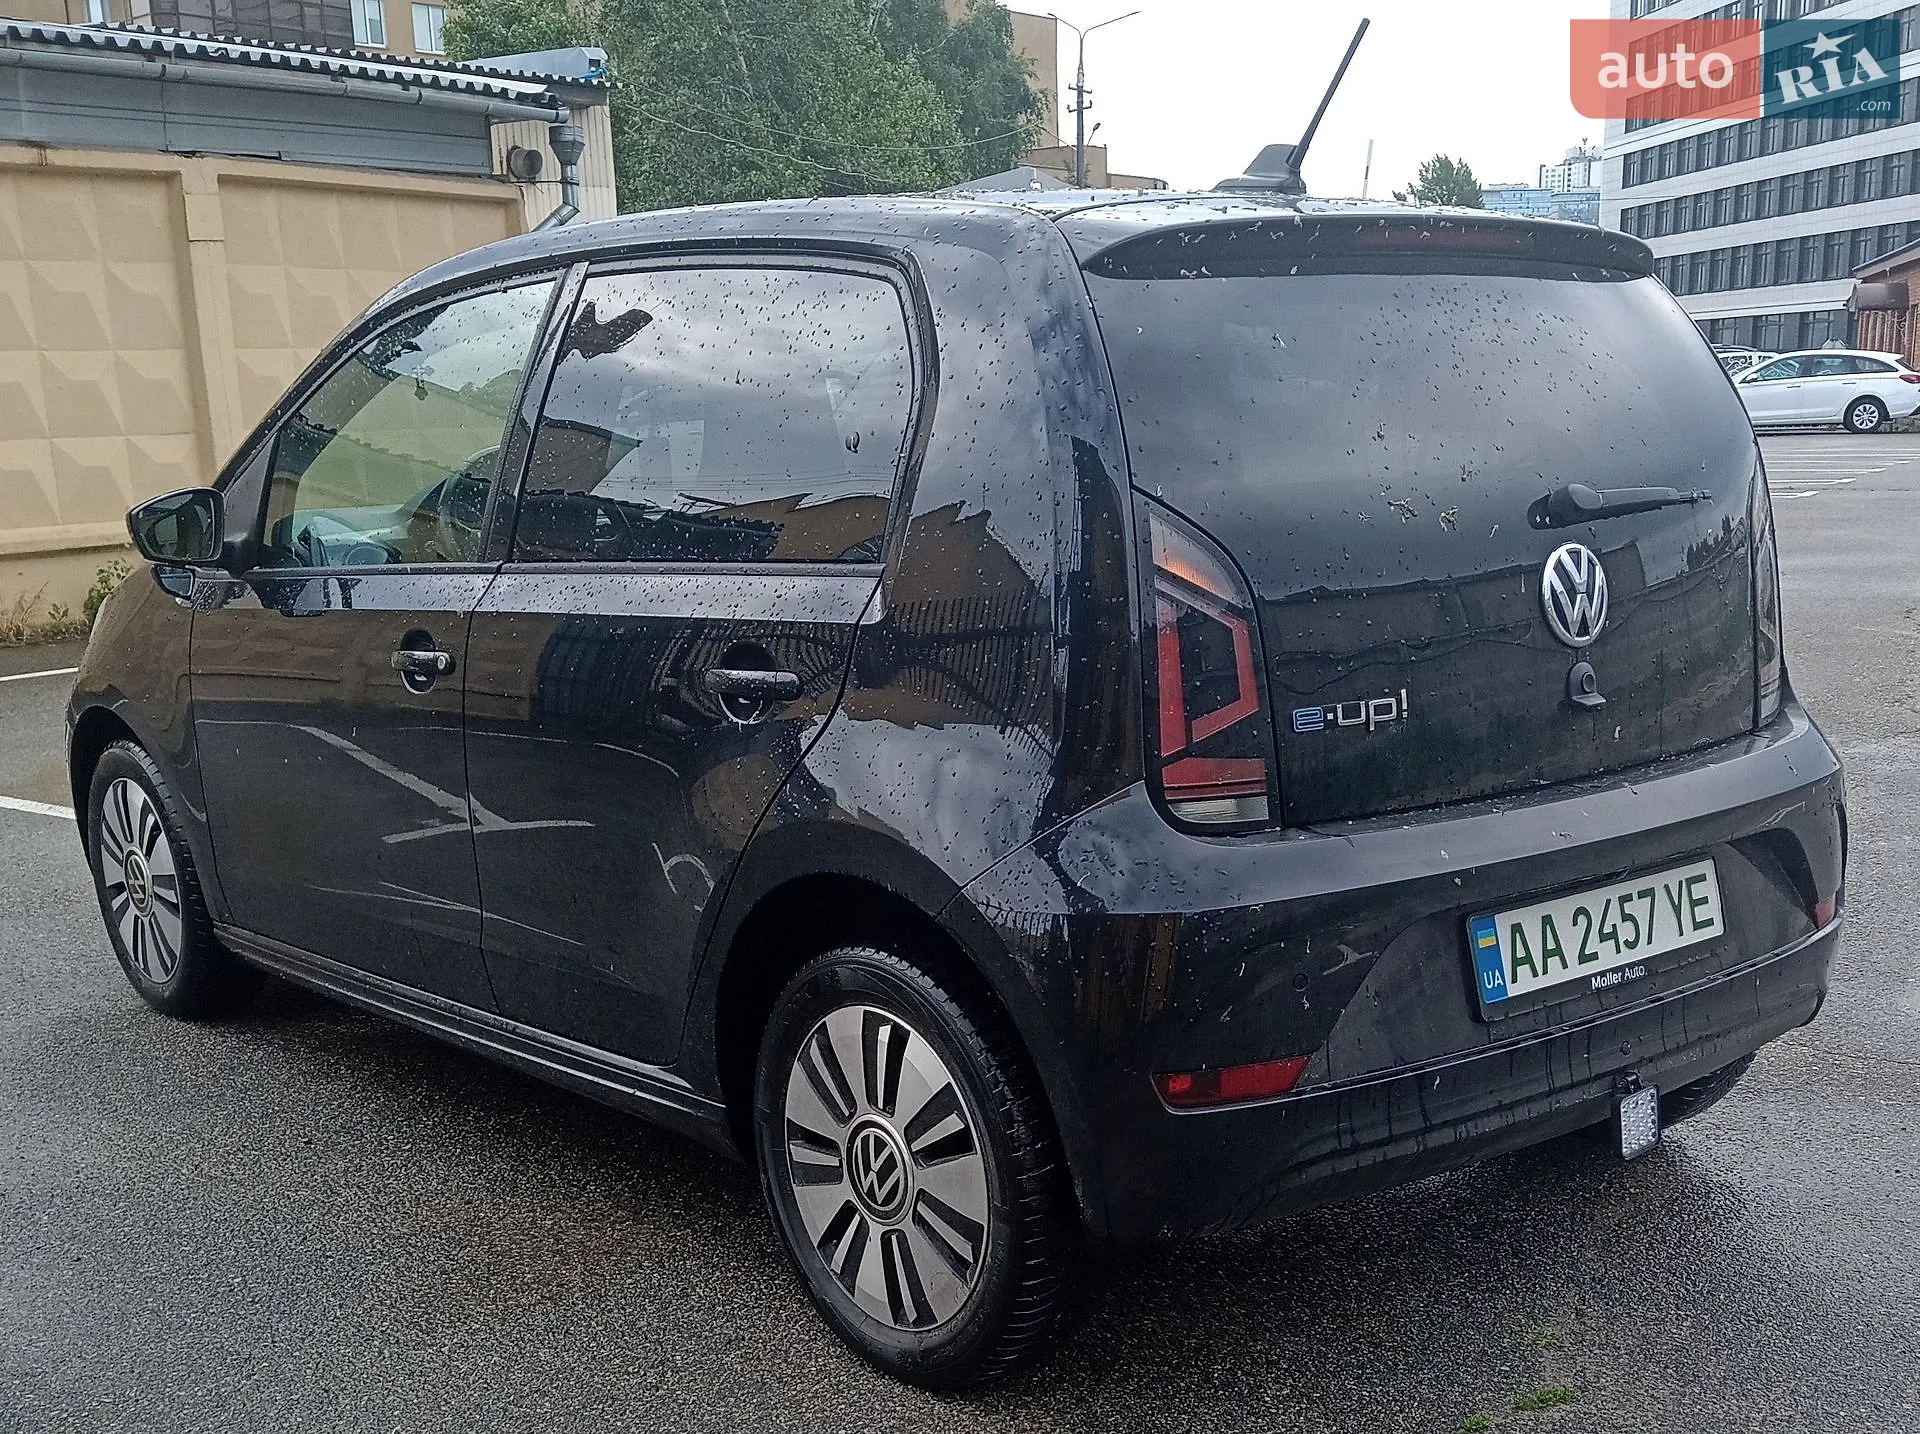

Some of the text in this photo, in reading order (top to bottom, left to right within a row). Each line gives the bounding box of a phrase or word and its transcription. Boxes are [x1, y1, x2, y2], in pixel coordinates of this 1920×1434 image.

[1510, 873, 1715, 984] AA 2457 YE
[1483, 970, 1504, 989] UA
[1591, 971, 1622, 990] Moller
